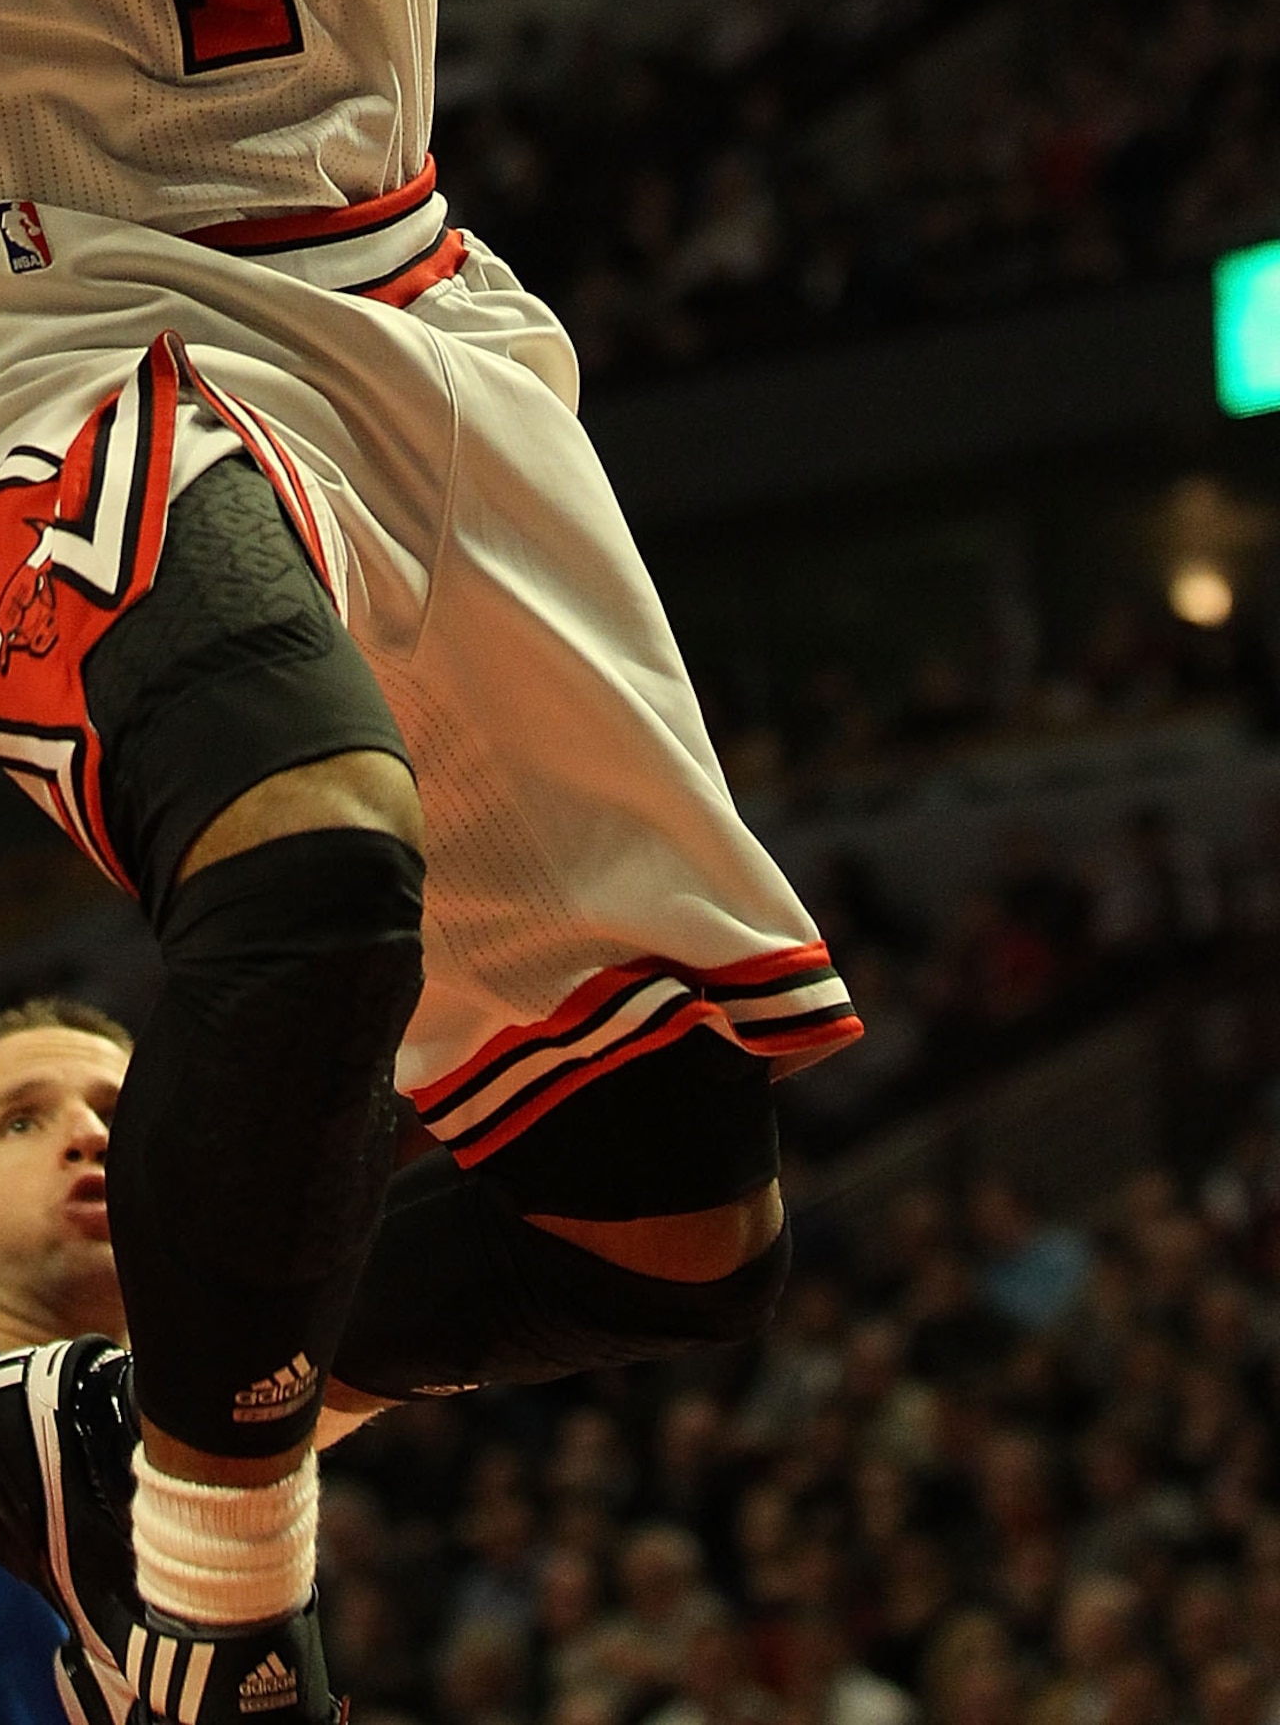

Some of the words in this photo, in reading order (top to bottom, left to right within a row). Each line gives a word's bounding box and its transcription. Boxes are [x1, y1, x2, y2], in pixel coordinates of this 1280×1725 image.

[12, 255, 40, 270] NBA
[233, 1364, 320, 1406] adidas
[238, 1666, 298, 1697] adidas
